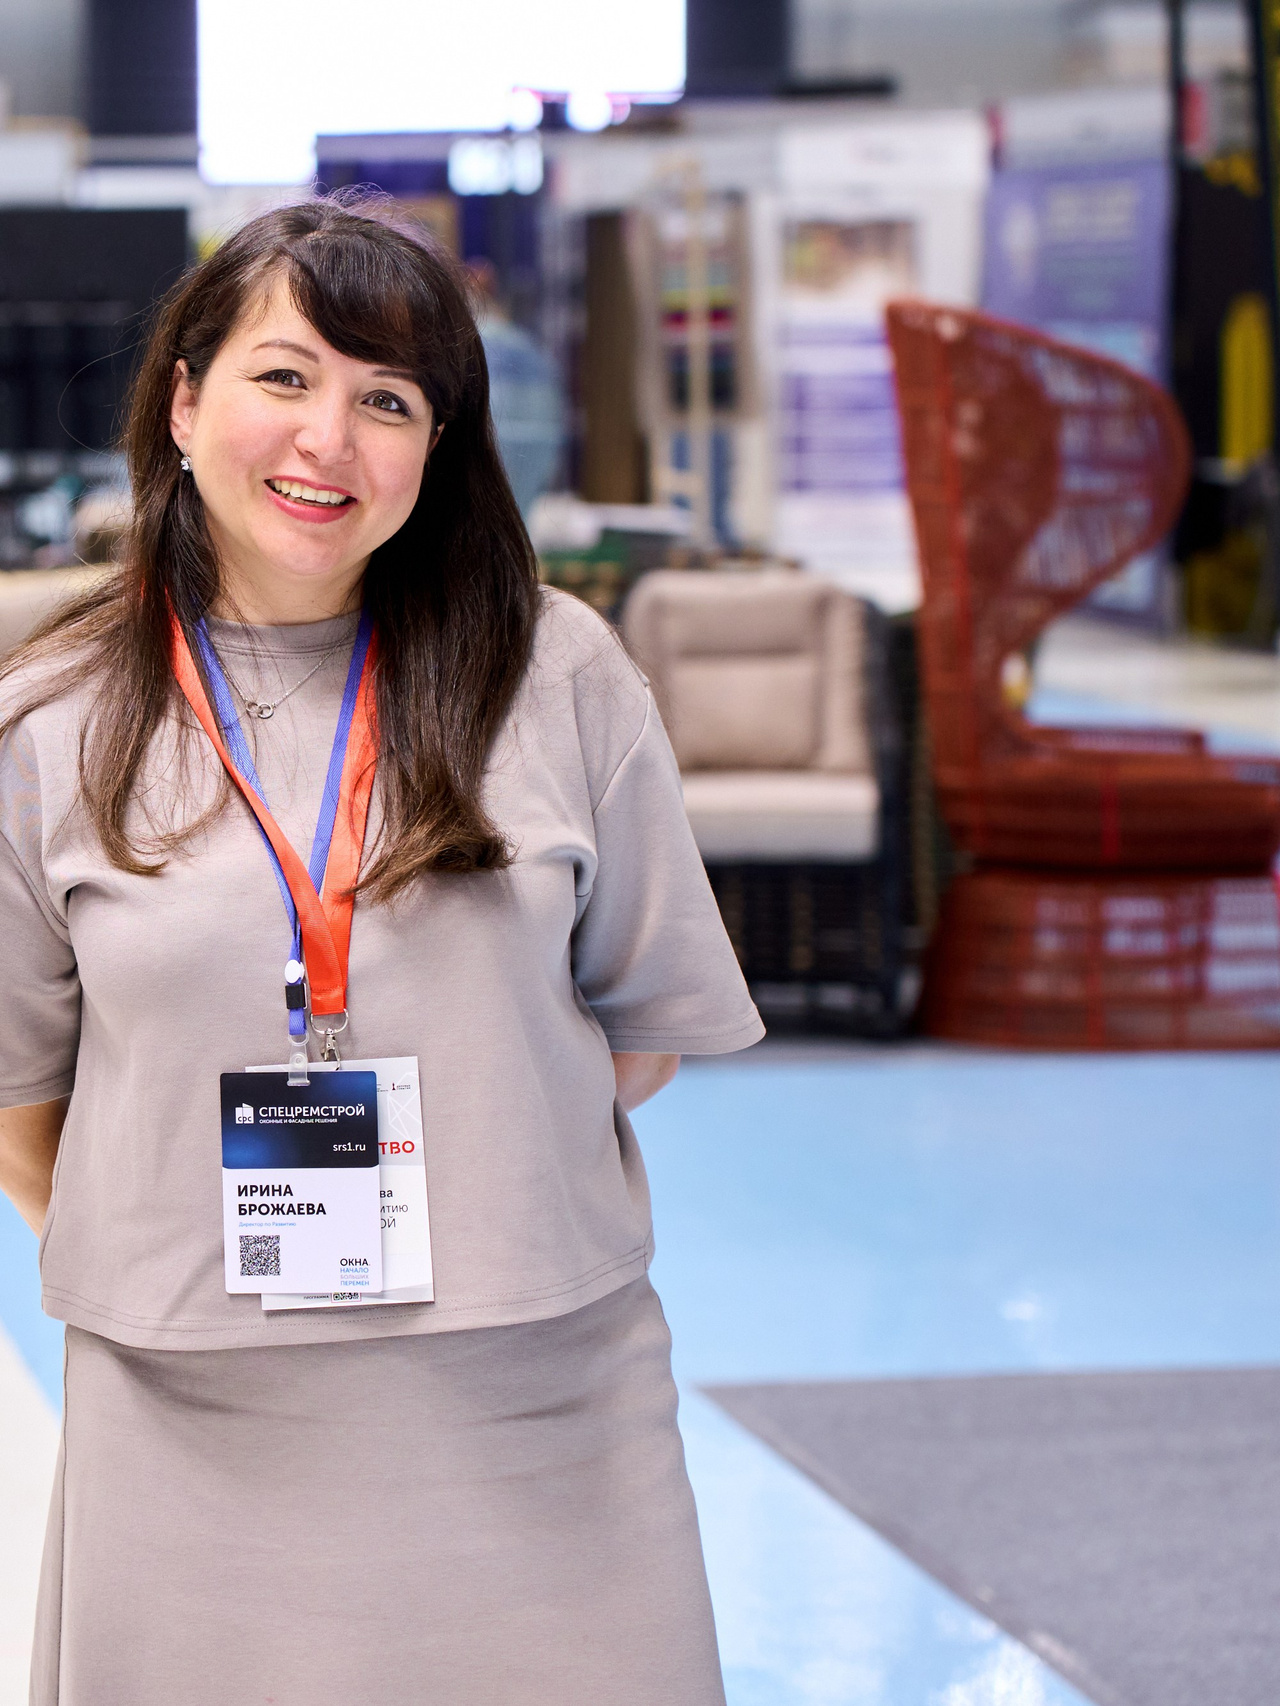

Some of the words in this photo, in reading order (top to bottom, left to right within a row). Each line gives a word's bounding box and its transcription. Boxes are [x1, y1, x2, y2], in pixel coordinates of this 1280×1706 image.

[259, 1103, 365, 1118] СПЕЦРЕМСТРОЙ
[333, 1142, 366, 1152] srs1.ru
[378, 1140, 415, 1155] ТВО
[237, 1184, 293, 1197] ИРИНА
[238, 1203, 326, 1216] БРОЖАЕВА
